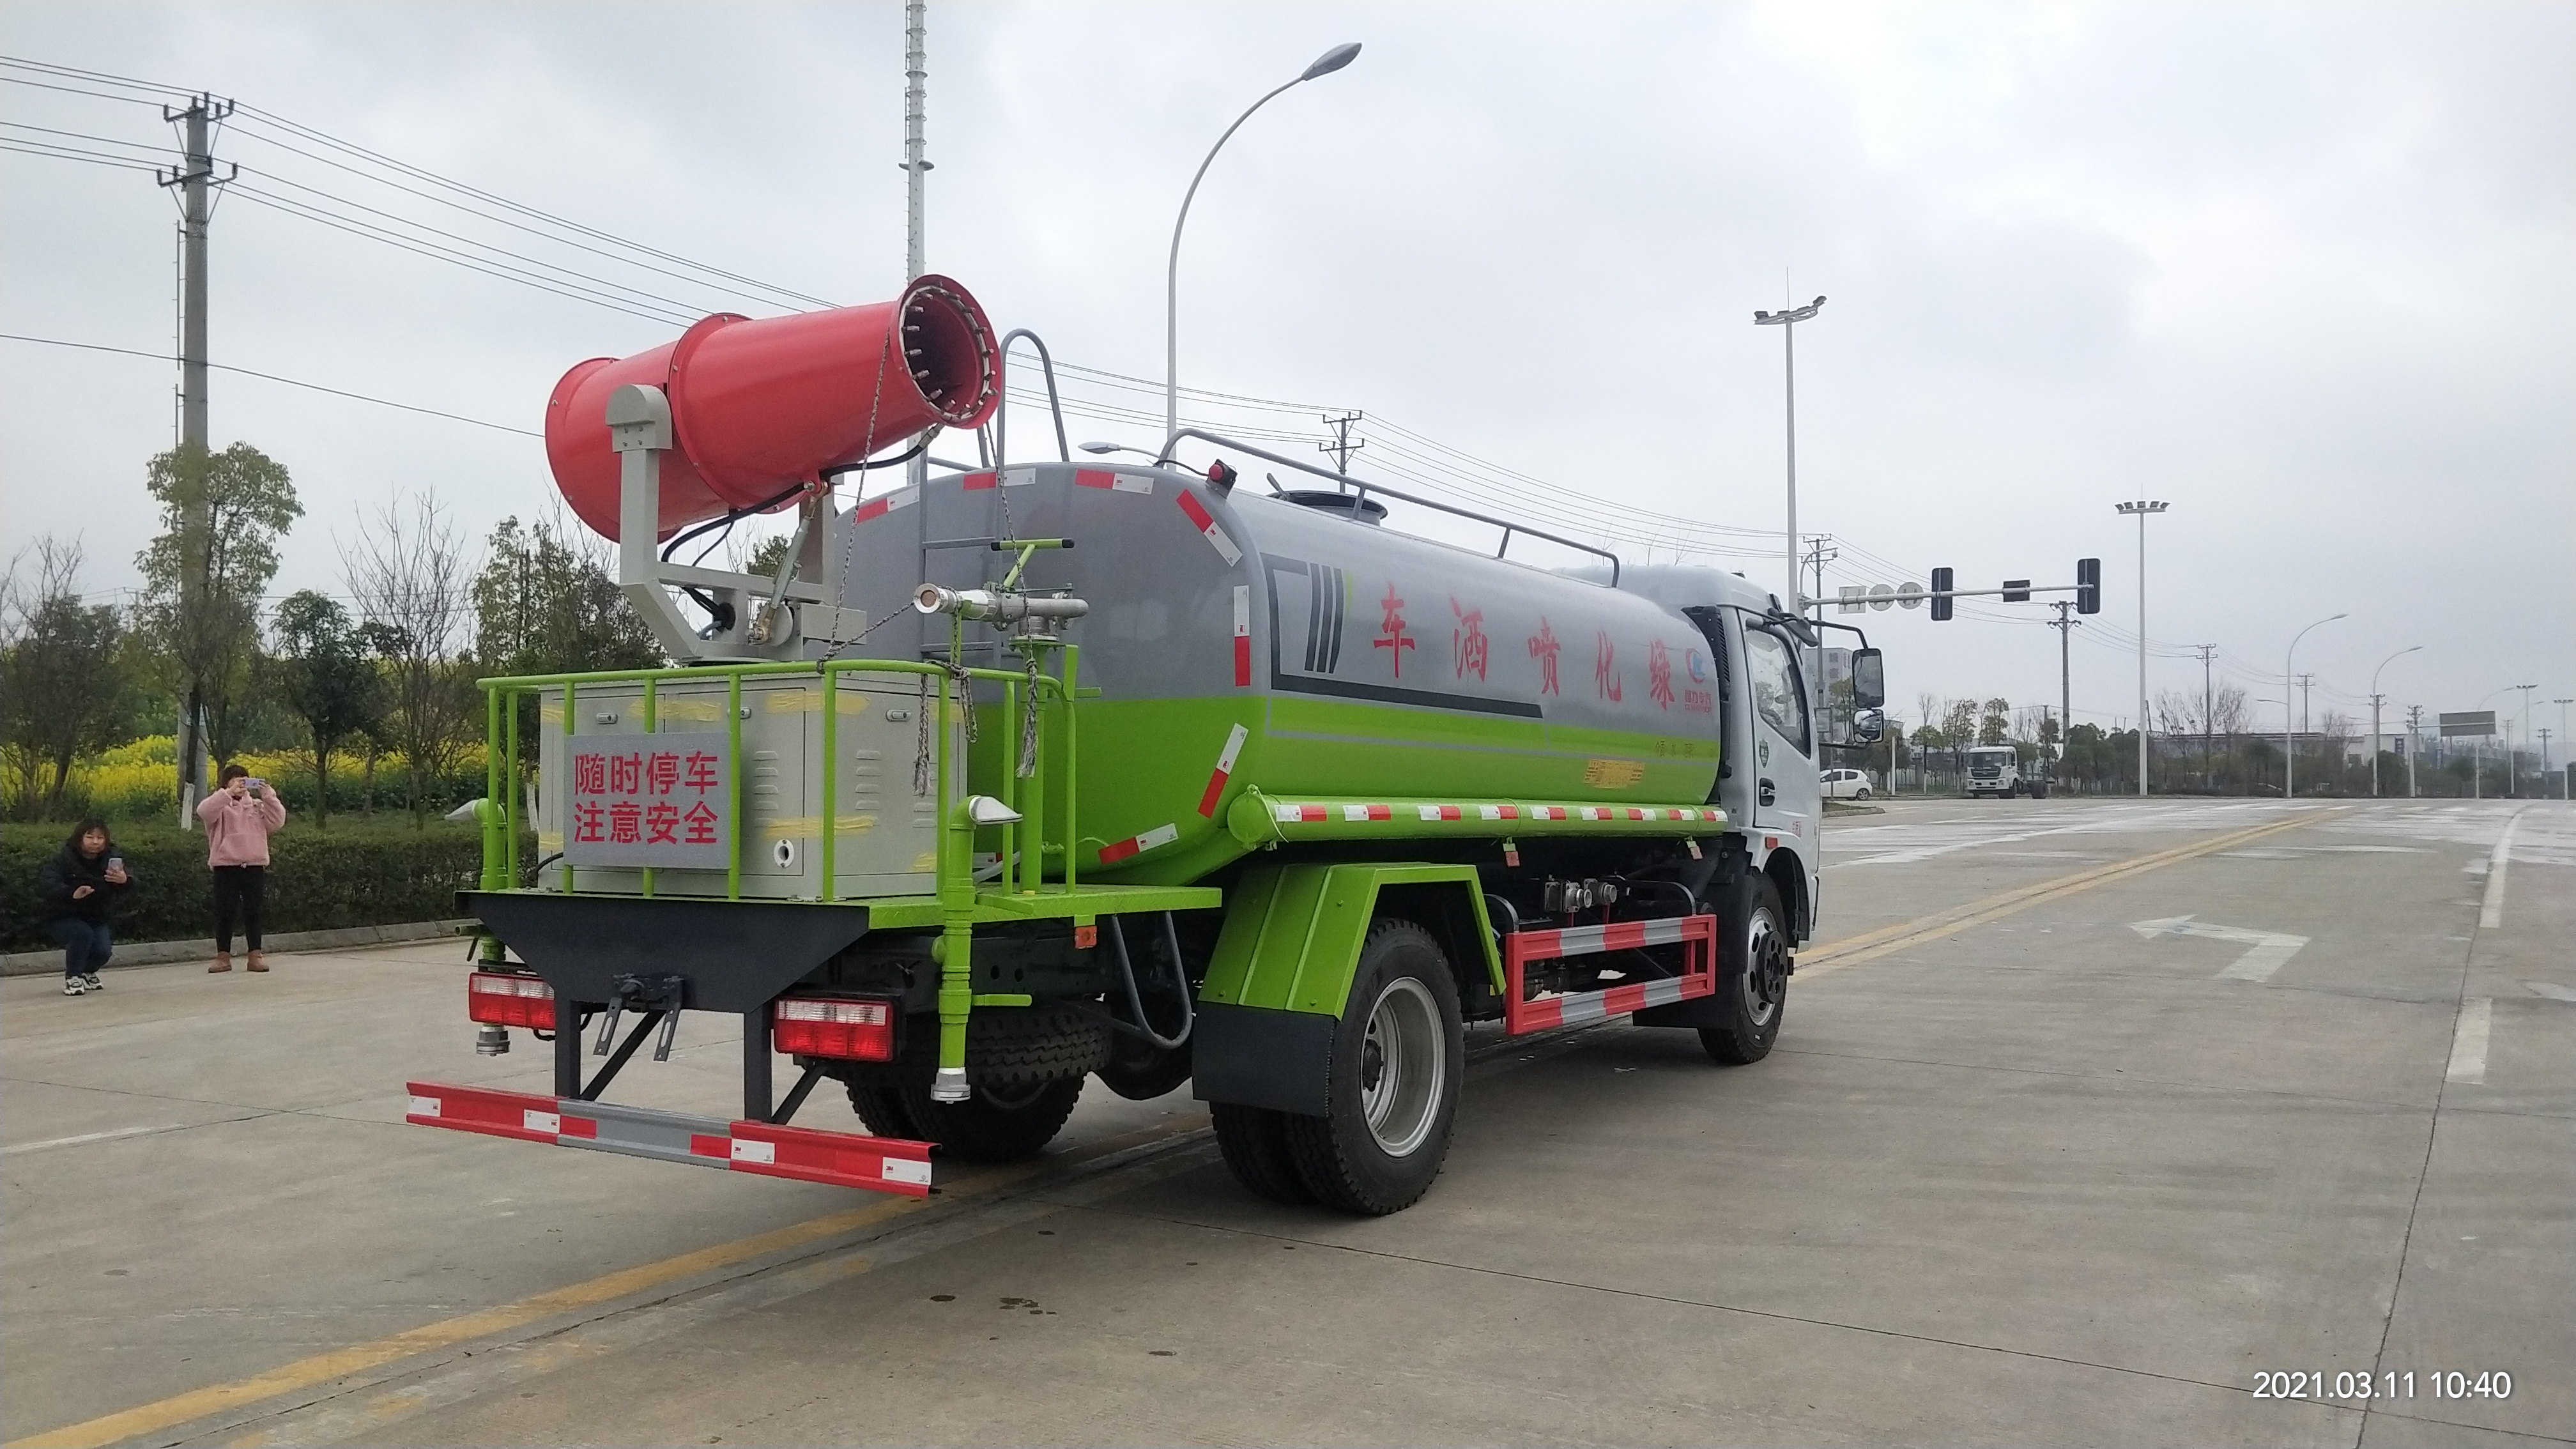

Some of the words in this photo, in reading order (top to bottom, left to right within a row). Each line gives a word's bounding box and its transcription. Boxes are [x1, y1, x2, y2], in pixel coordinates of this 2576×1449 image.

[574, 751, 719, 796] 随时停车
[574, 800, 719, 845] 注意安全
